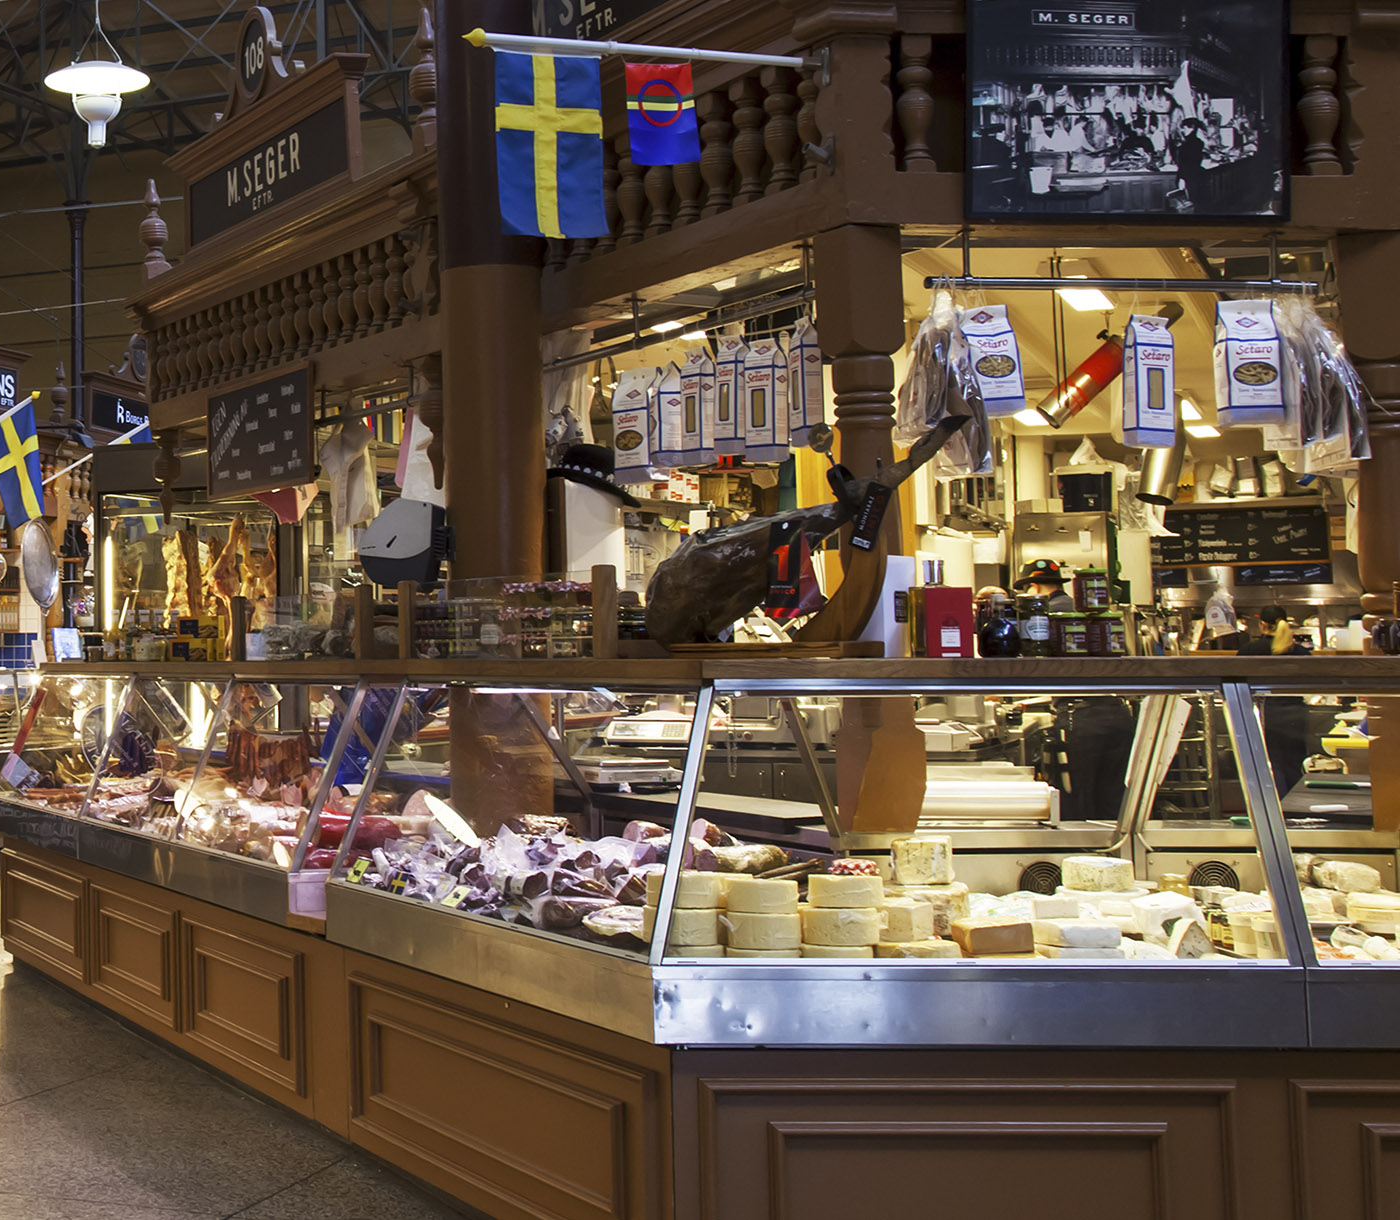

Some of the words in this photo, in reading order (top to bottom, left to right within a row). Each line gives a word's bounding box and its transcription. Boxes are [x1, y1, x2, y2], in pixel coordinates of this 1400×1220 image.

[576, 8, 616, 40] EFTR.
[1038, 13, 1059, 23] M.
[1068, 13, 1129, 25] SEGER
[244, 36, 264, 79] 108
[252, 191, 274, 211] EFTR.
[977, 339, 1008, 348] Setaro
[1235, 344, 1273, 355] Setaro
[1140, 350, 1171, 361] Setaro
[859, 496, 875, 531] MONTARAZ
[773, 544, 790, 581] 1
